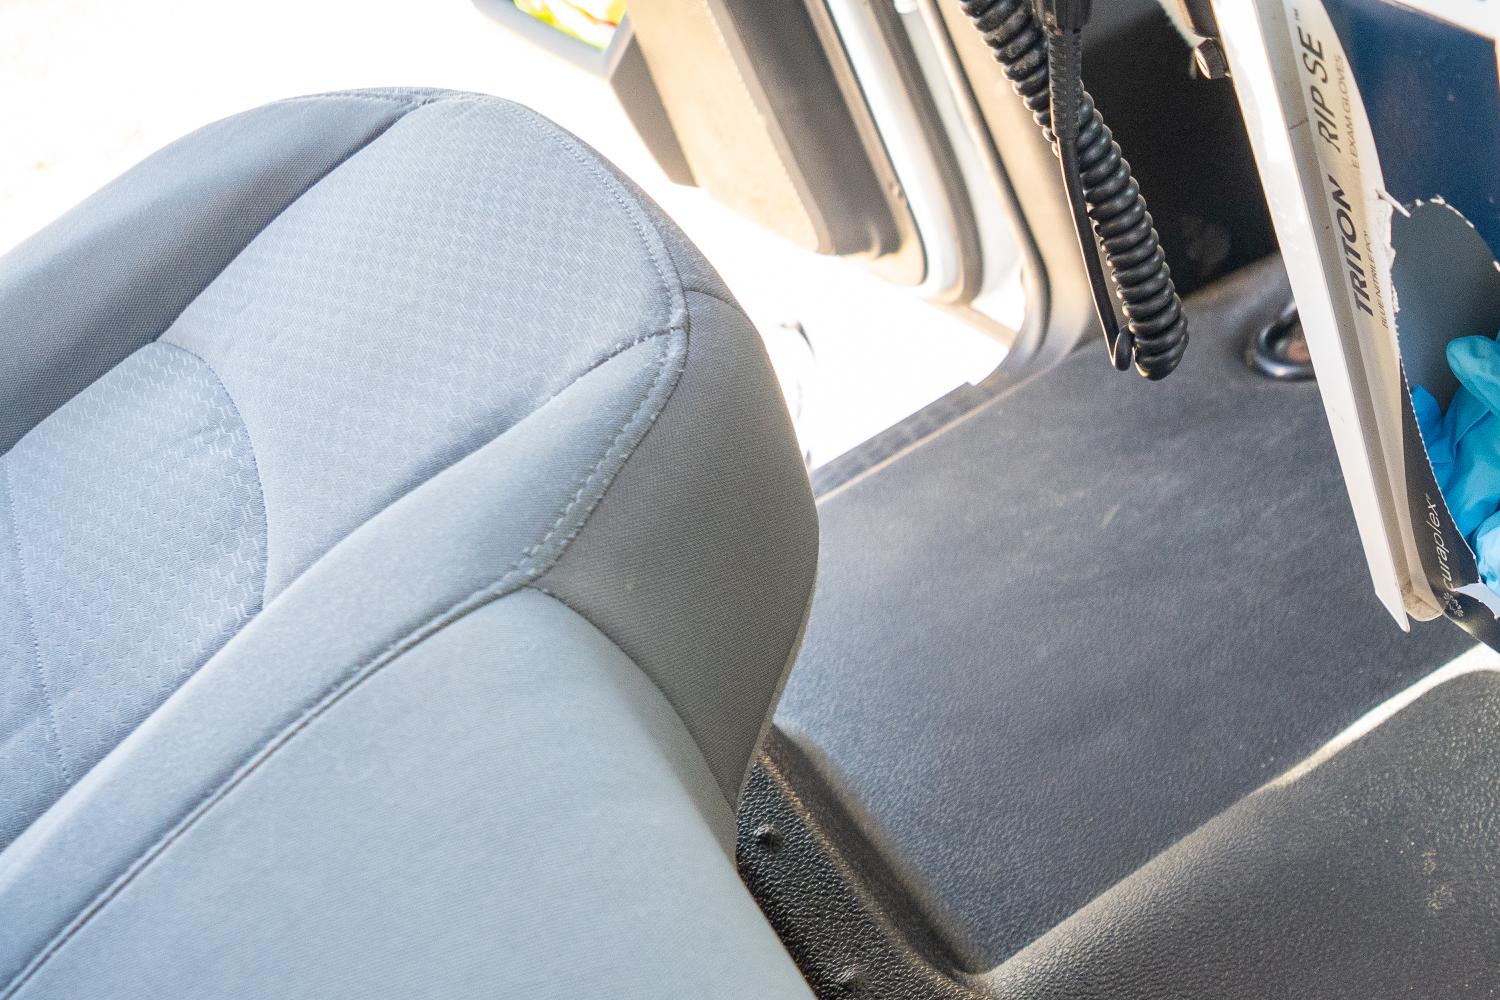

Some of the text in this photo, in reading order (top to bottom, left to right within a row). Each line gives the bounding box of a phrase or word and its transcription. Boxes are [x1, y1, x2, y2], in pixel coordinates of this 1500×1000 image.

[1334, 55, 1353, 113] GLOVES
[1310, 85, 1342, 153] RIP
[1343, 113, 1359, 158] EXAM
[1328, 174, 1374, 316] TRITON
[1367, 253, 1383, 297] NITRILE
[1376, 298, 1389, 328] BLUE
[1426, 500, 1455, 591] curaplex
